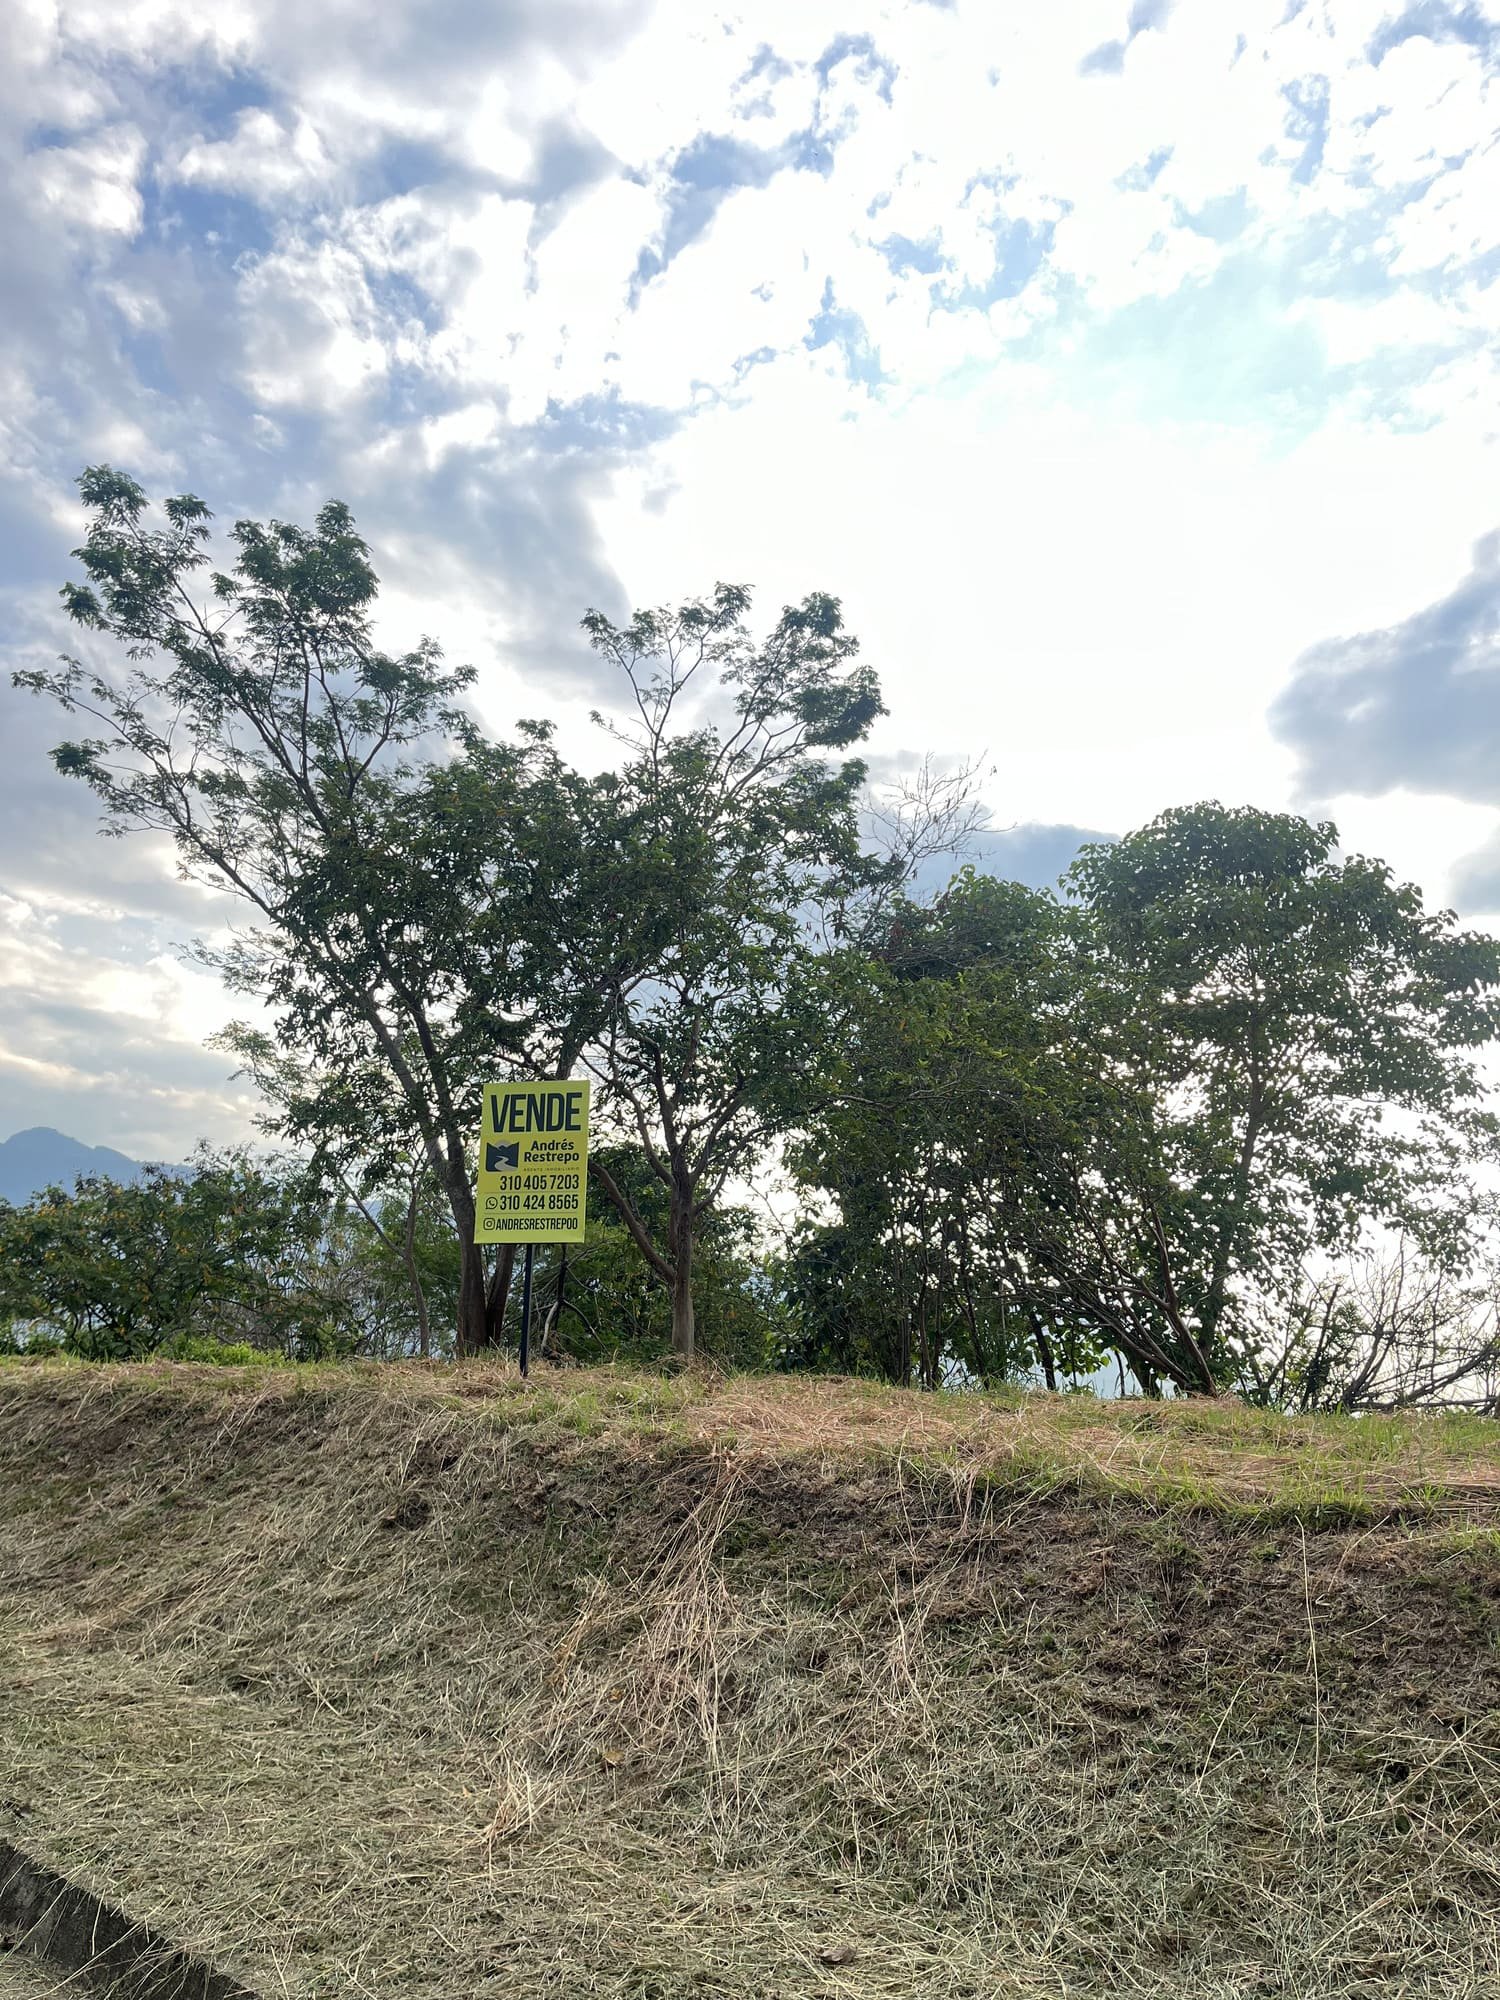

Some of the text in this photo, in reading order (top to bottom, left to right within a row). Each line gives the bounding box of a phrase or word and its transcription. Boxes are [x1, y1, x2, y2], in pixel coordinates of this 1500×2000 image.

[490, 1092, 583, 1133] VENDE
[530, 1138, 575, 1151] Andrés
[523, 1151, 580, 1164] Restrepo
[500, 1174, 579, 1190] 310 405 7203
[500, 1194, 579, 1210] 310 424 8565
[495, 1217, 578, 1231] ANDRESRESTREPOO
